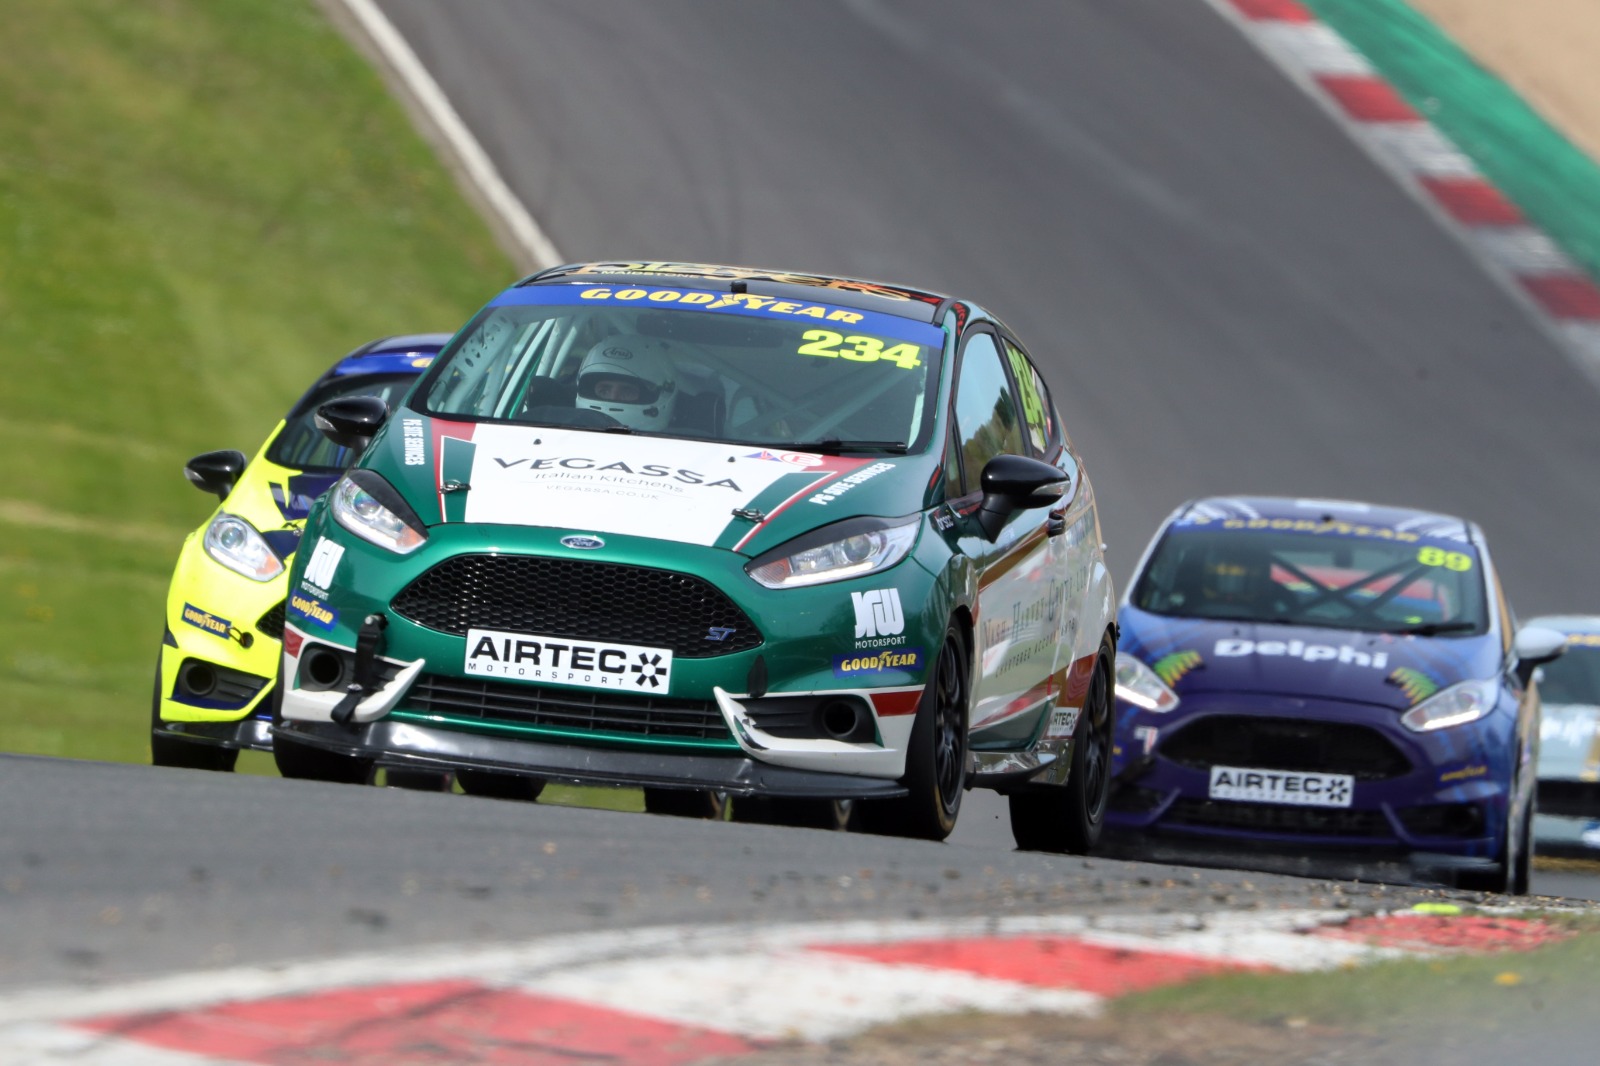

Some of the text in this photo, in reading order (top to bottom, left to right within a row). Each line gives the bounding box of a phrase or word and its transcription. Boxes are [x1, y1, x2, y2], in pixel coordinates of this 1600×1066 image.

[601, 270, 699, 279] MAIDSTONE
[798, 329, 921, 370] 234
[493, 457, 743, 492] VEGASSA
[535, 472, 684, 493] Italian Kitchens
[808, 462, 896, 505] PG SITE SERVICES
[1416, 545, 1472, 572] 89
[291, 596, 334, 625] GOODYEAR
[704, 626, 737, 641] ST
[855, 636, 906, 649] MOTORSPORT
[470, 636, 627, 674] AIRTEC
[841, 651, 917, 672] GOODYEAR
[1214, 638, 1389, 669] Delphi
[468, 662, 624, 686] MOTORSPORT
[1215, 771, 1323, 795] AIRTEC
